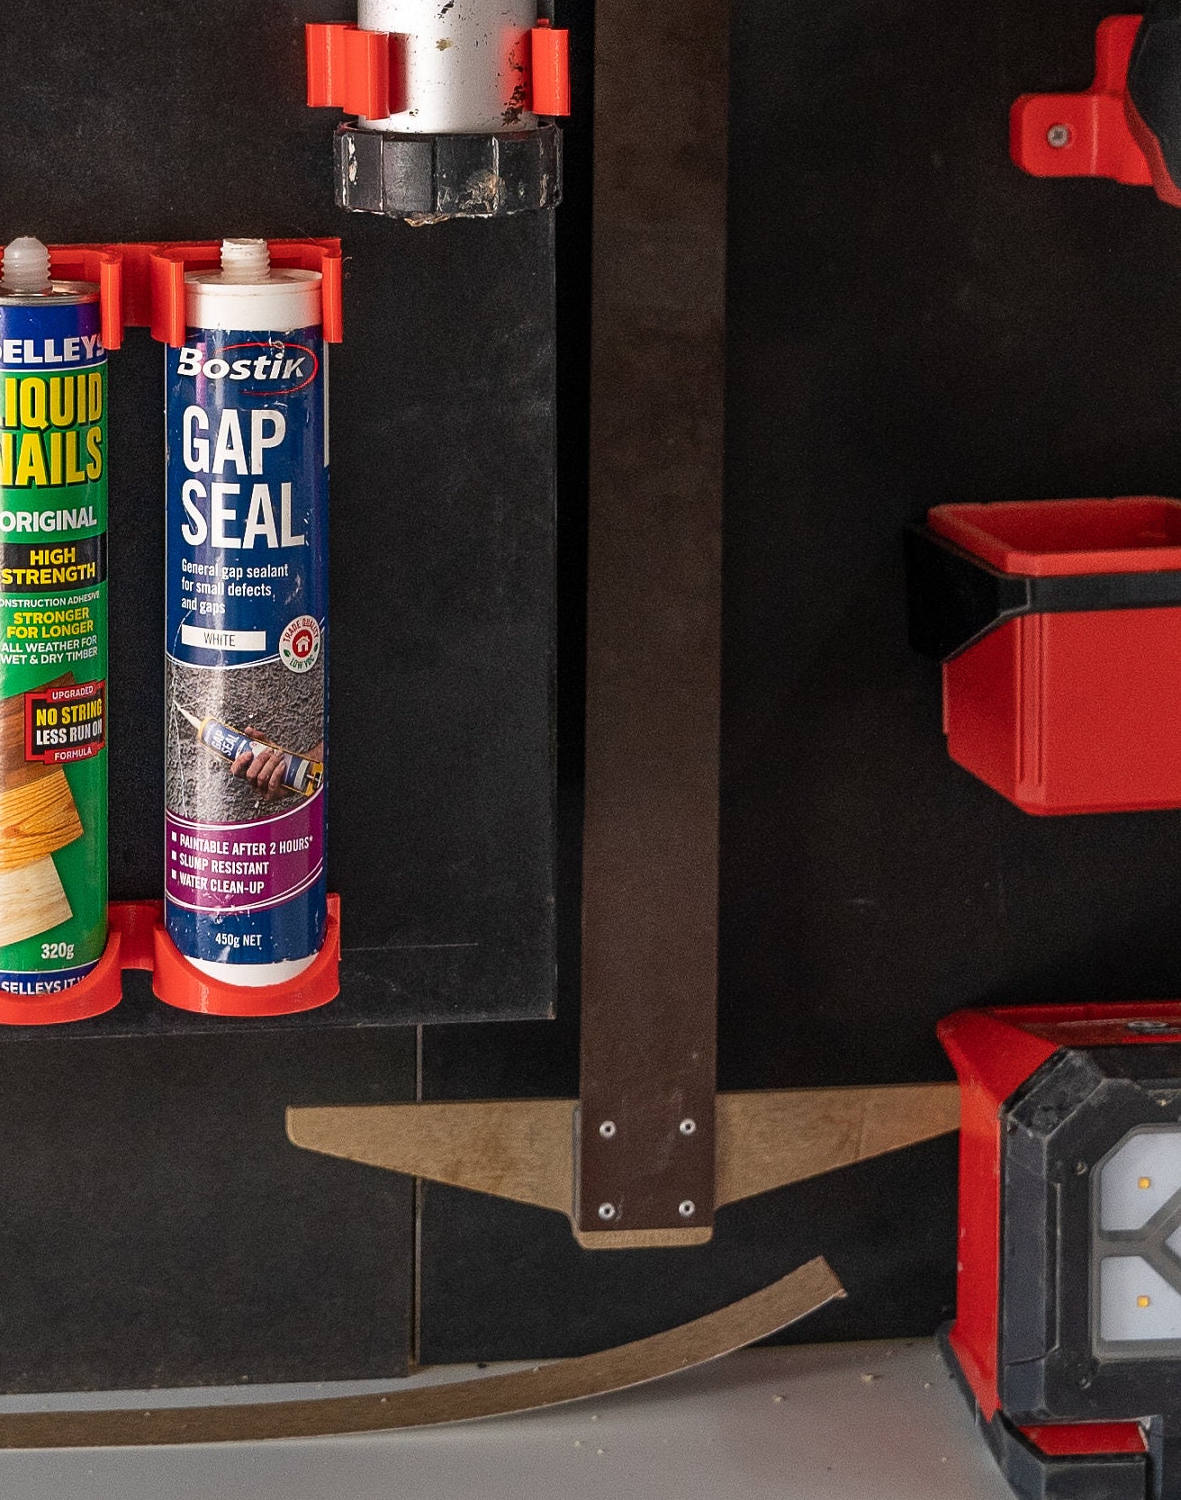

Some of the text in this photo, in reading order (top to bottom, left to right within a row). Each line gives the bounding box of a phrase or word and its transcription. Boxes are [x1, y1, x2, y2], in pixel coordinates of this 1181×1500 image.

[177, 347, 306, 380] Bostik
[182, 404, 287, 476] GAP
[181, 478, 305, 549] SEAL
[30, 547, 76, 566] HIGH
[1, 562, 96, 585] STRENGTH
[181, 557, 289, 580] General gap sealant
[181, 576, 272, 597] for small defects
[13, 607, 90, 624] STRONGER
[181, 597, 226, 615] and gaps
[6, 620, 94, 639] FOR LONGER
[203, 631, 236, 647] WHITE
[283, 620, 301, 642] TRADE
[1, 635, 98, 653] ALL WEATHER FOR
[0, 646, 98, 665] WET & DRY TIMBER
[52, 685, 94, 700] UPGRADED
[36, 698, 102, 726] NO STRING
[36, 718, 103, 746] LESS RUN ON
[54, 746, 92, 761] FORMULA
[221, 733, 240, 757] SEAL
[179, 833, 229, 855] PAINTABLE
[231, 842, 266, 856] AFTER
[269, 842, 276, 855] 2
[179, 852, 269, 875] SLUMP RESISTANT
[179, 871, 265, 894] WATER CLEAN-UP
[215, 932, 262, 948] 450g NET
[41, 942, 75, 960] 320g
[1, 980, 61, 995] SELLEYS
